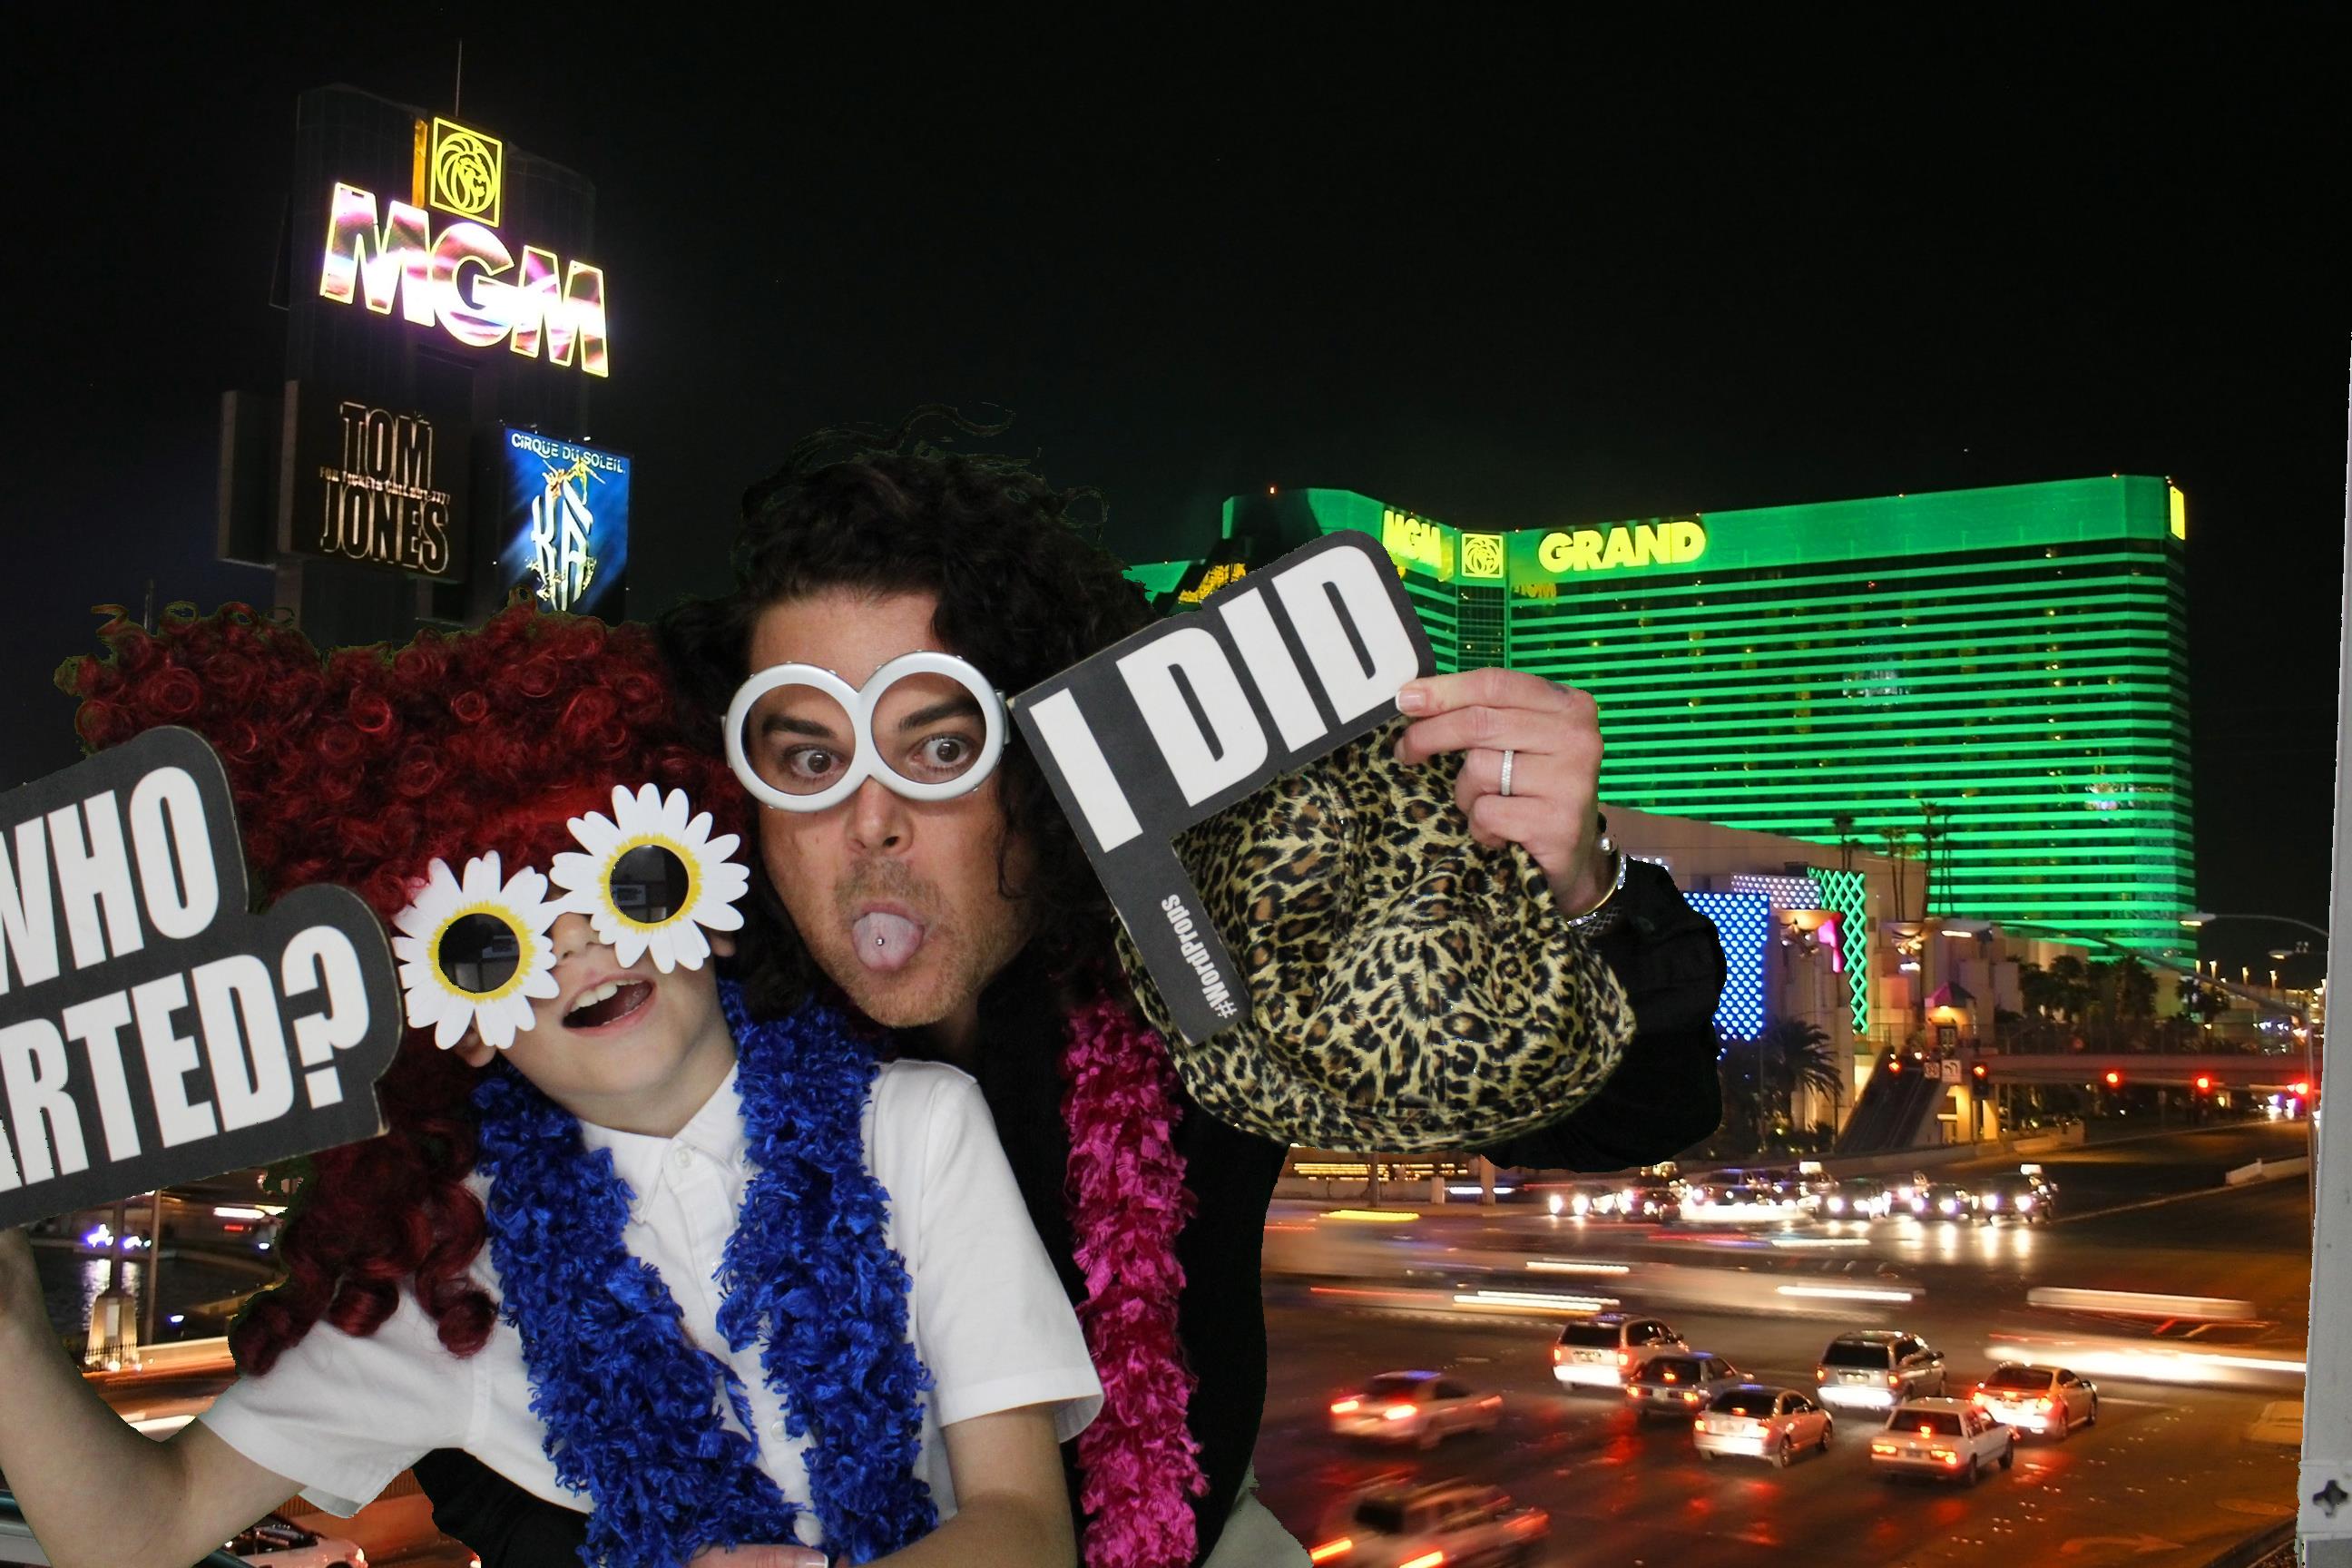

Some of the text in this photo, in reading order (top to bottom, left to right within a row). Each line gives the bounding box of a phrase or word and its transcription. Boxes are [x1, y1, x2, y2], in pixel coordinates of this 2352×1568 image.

[319, 182, 609, 377] MGM
[339, 401, 433, 490] TOM
[511, 433, 624, 474] CIRQUE DU SOLEIL
[320, 481, 449, 573] JONES
[1382, 510, 1706, 573] MGM GRAND
[1029, 545, 1419, 853] I DID
[0, 767, 220, 995] WHO
[1161, 894, 1238, 1018] #WordProps
[0, 926, 369, 1191] RTED?
